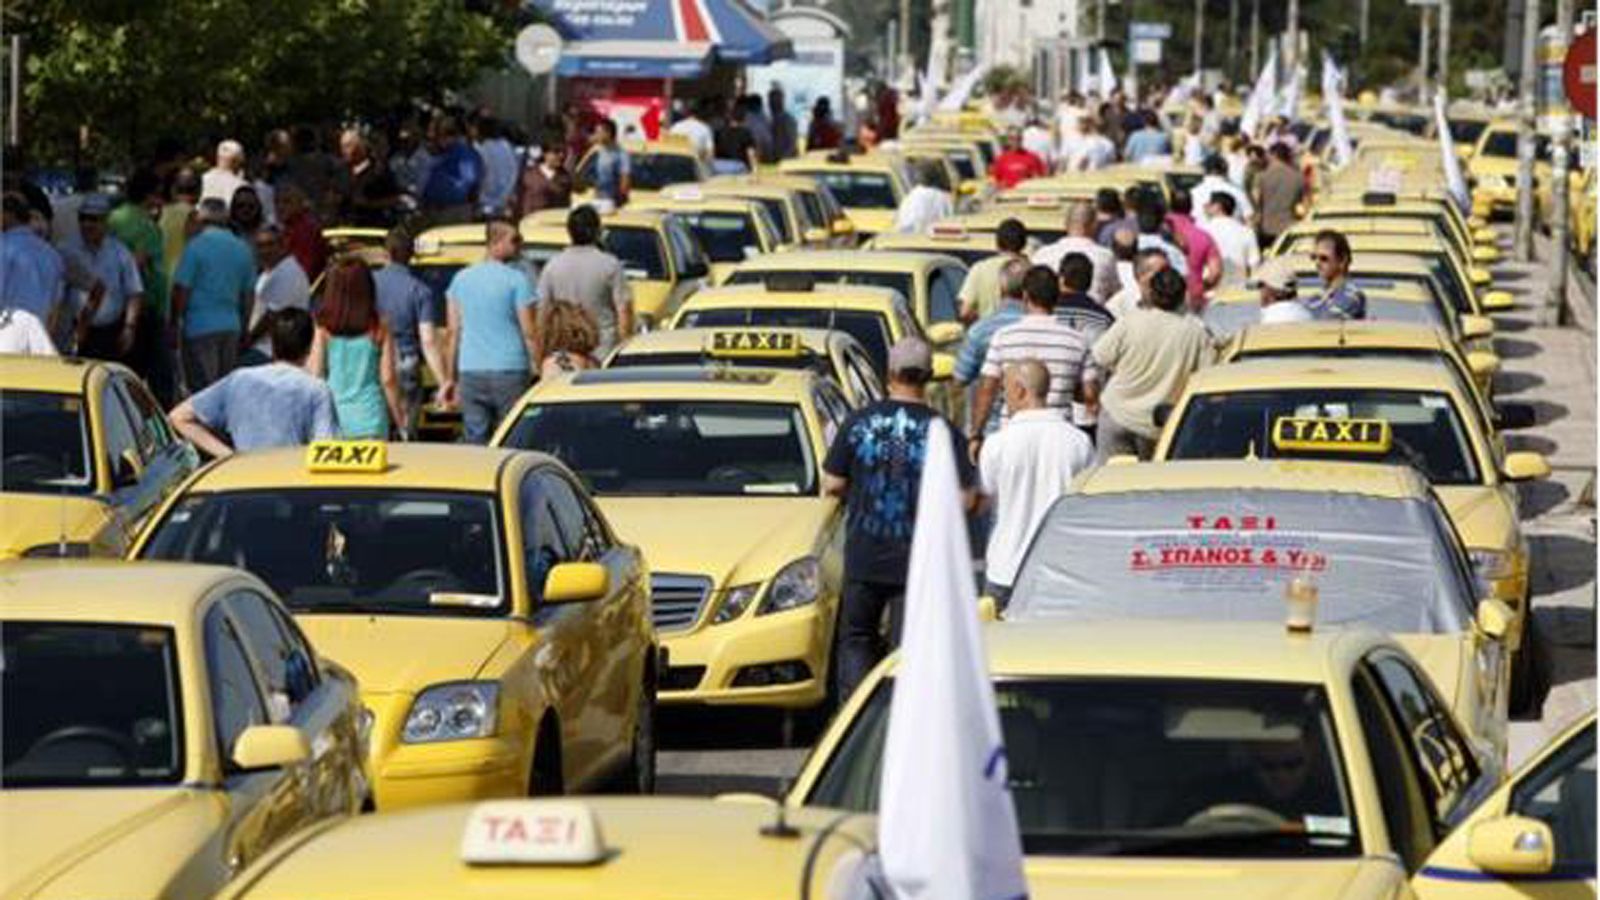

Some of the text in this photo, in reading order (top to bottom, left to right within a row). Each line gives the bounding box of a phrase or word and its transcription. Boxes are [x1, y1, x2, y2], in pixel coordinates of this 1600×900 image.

[722, 332, 783, 350] TAXI
[1293, 421, 1369, 441] TAXI
[313, 445, 379, 464] TAXI
[1160, 548, 1254, 564] ΣΠΑΝΟΣ
[1261, 550, 1277, 564] &
[481, 815, 577, 846] ΤΑΞΙ
